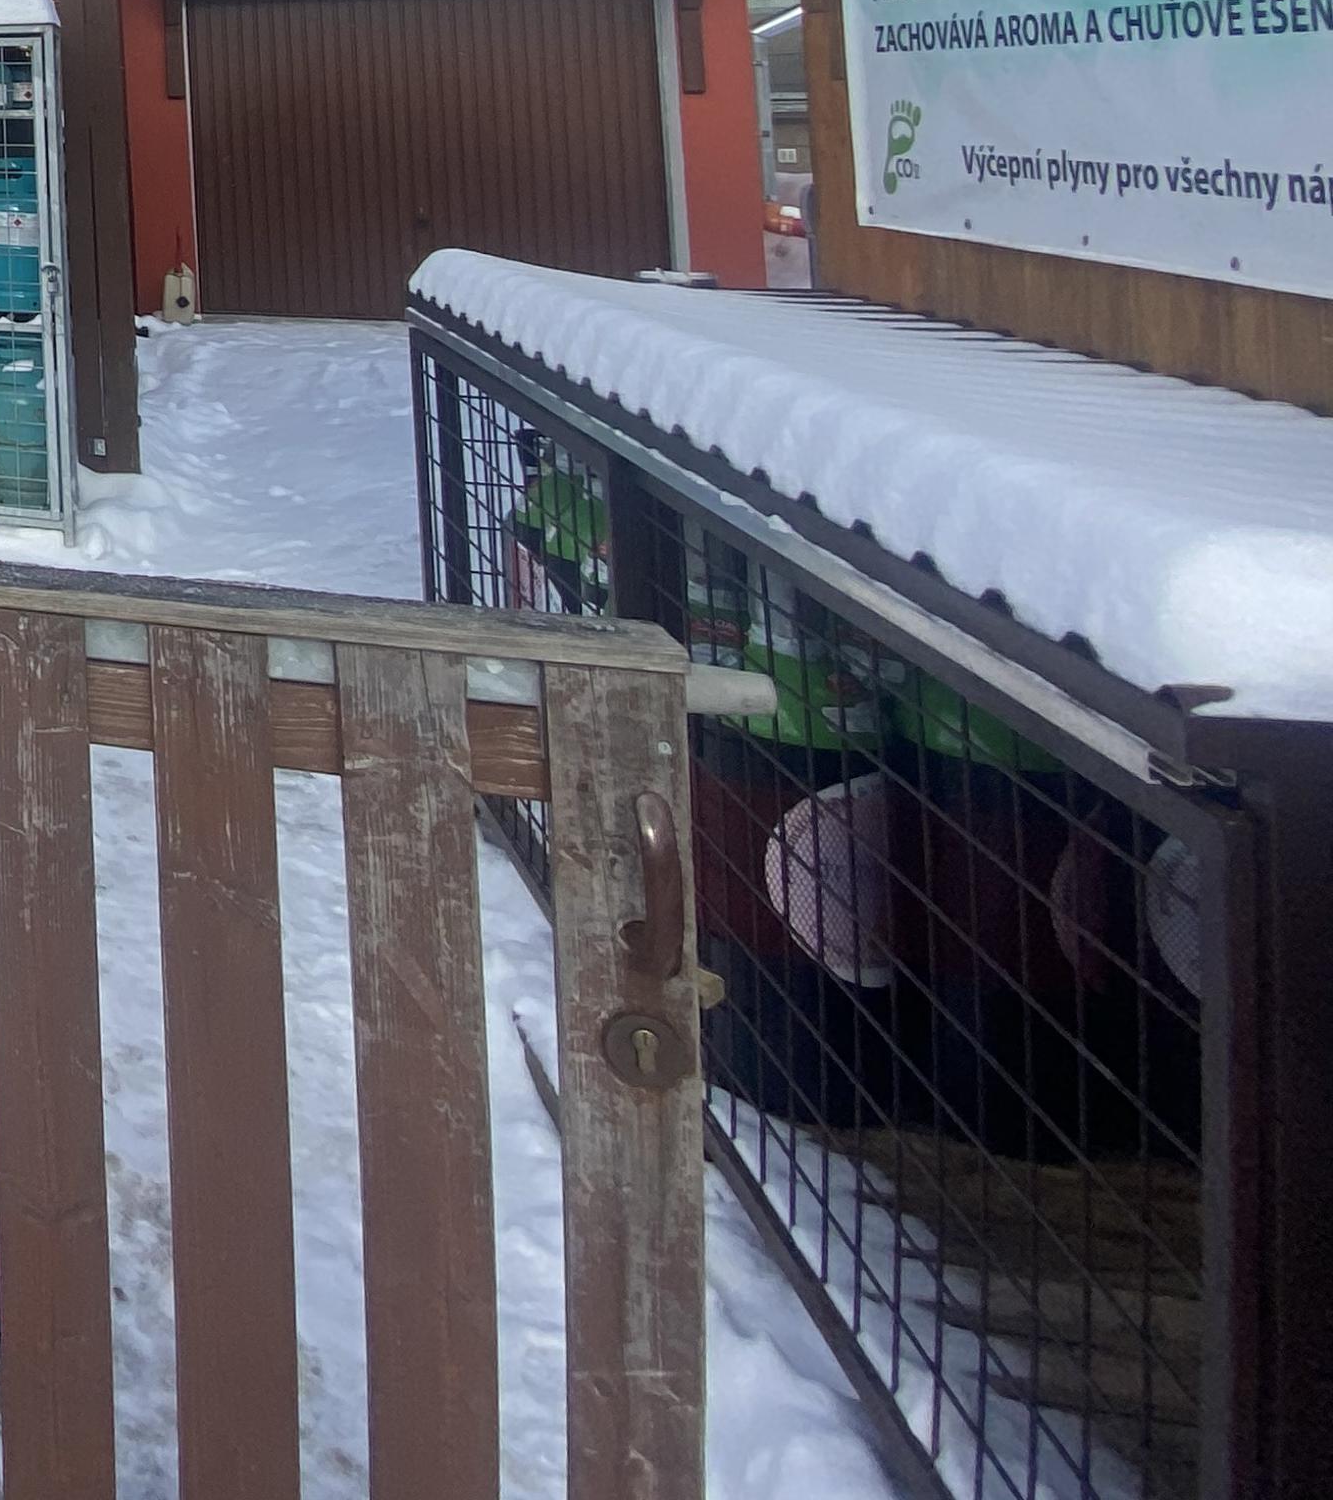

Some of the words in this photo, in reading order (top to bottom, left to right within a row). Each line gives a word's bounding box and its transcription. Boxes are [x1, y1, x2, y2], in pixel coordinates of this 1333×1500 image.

[874, 10, 989, 53] ZACHOVÁVÁ
[994, 11, 1079, 48] AROMA
[1085, 8, 1103, 43] A
[961, 145, 1042, 187] Výčepní
[1047, 149, 1110, 194] plyny
[1116, 162, 1159, 197] pro
[1165, 155, 1279, 211] všechny
